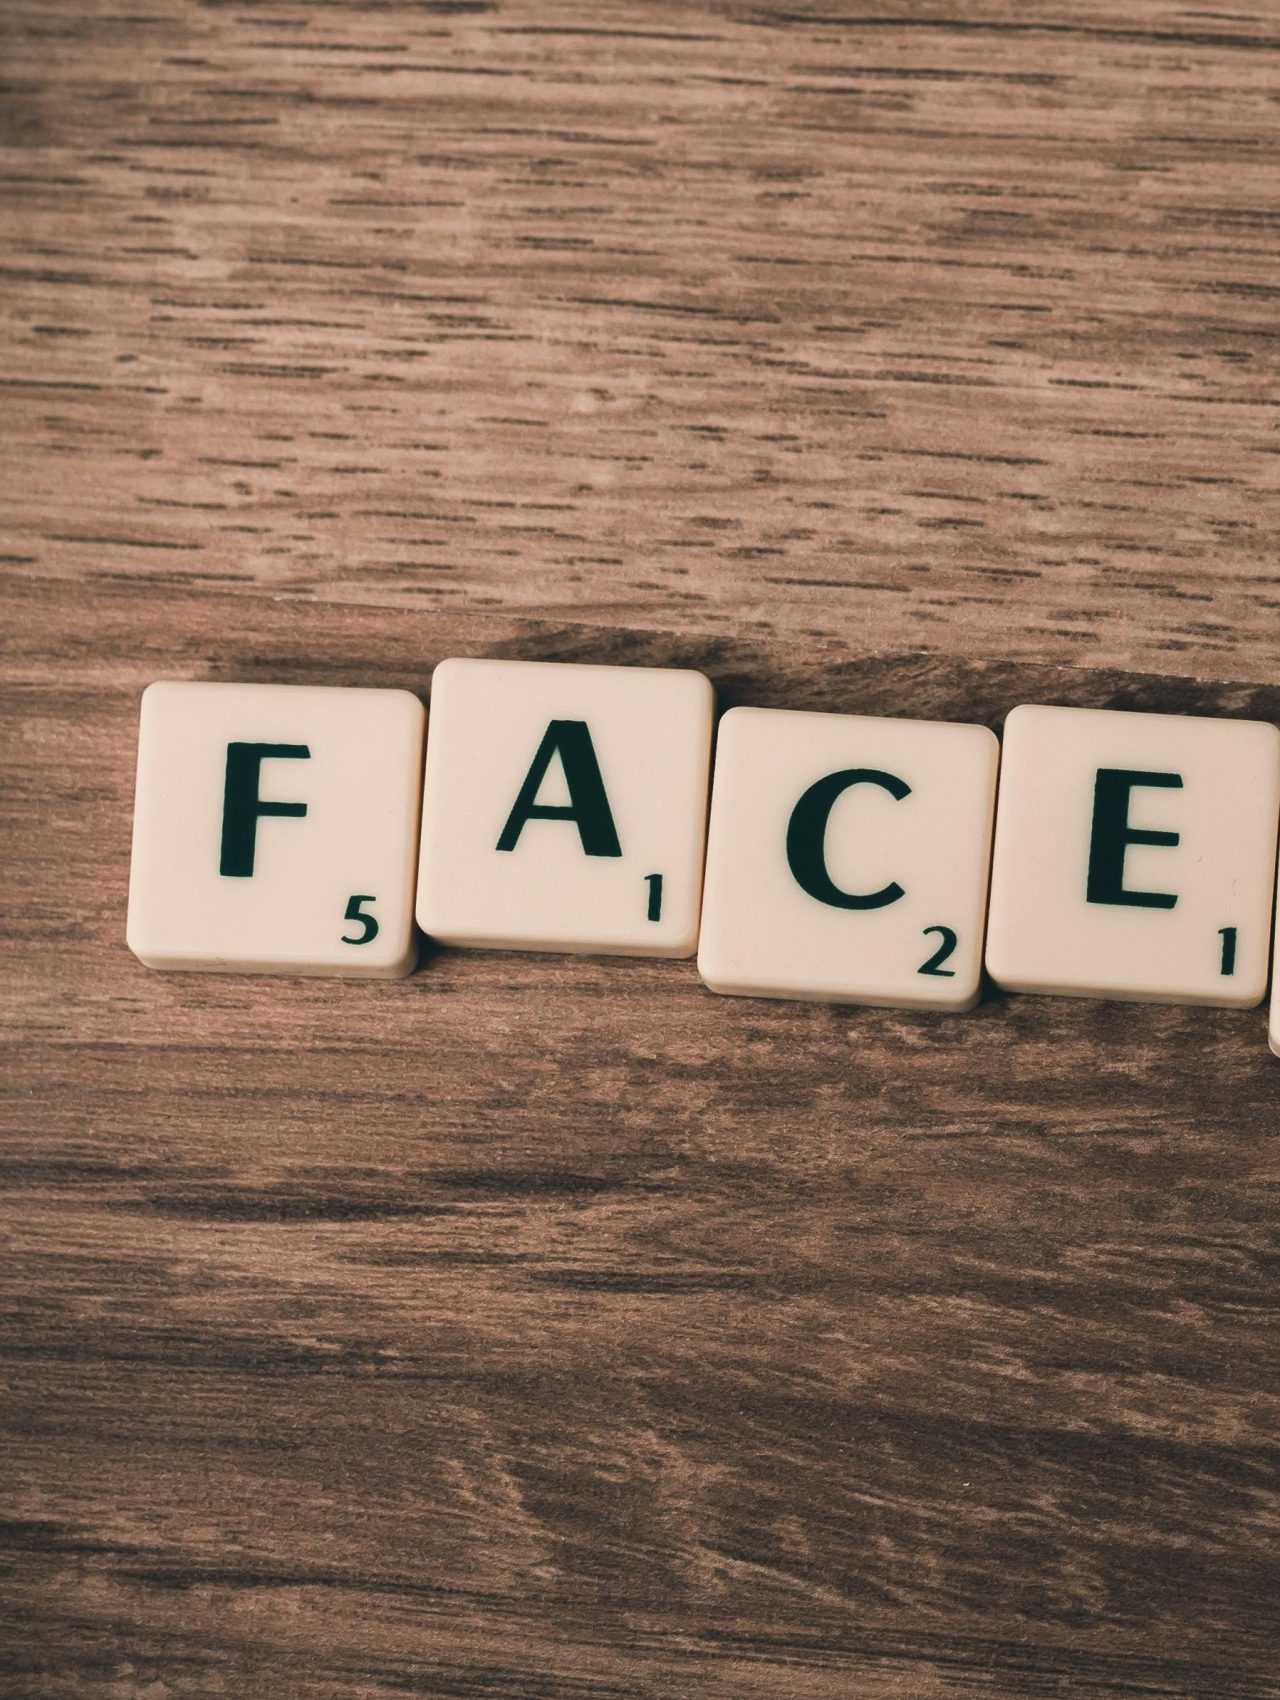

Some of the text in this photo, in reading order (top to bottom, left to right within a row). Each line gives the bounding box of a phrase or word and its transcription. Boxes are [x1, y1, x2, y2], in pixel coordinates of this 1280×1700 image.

[340, 894, 379, 946] 5
[643, 872, 664, 923] 1
[917, 925, 958, 978] 2
[1216, 925, 1239, 977] 1
